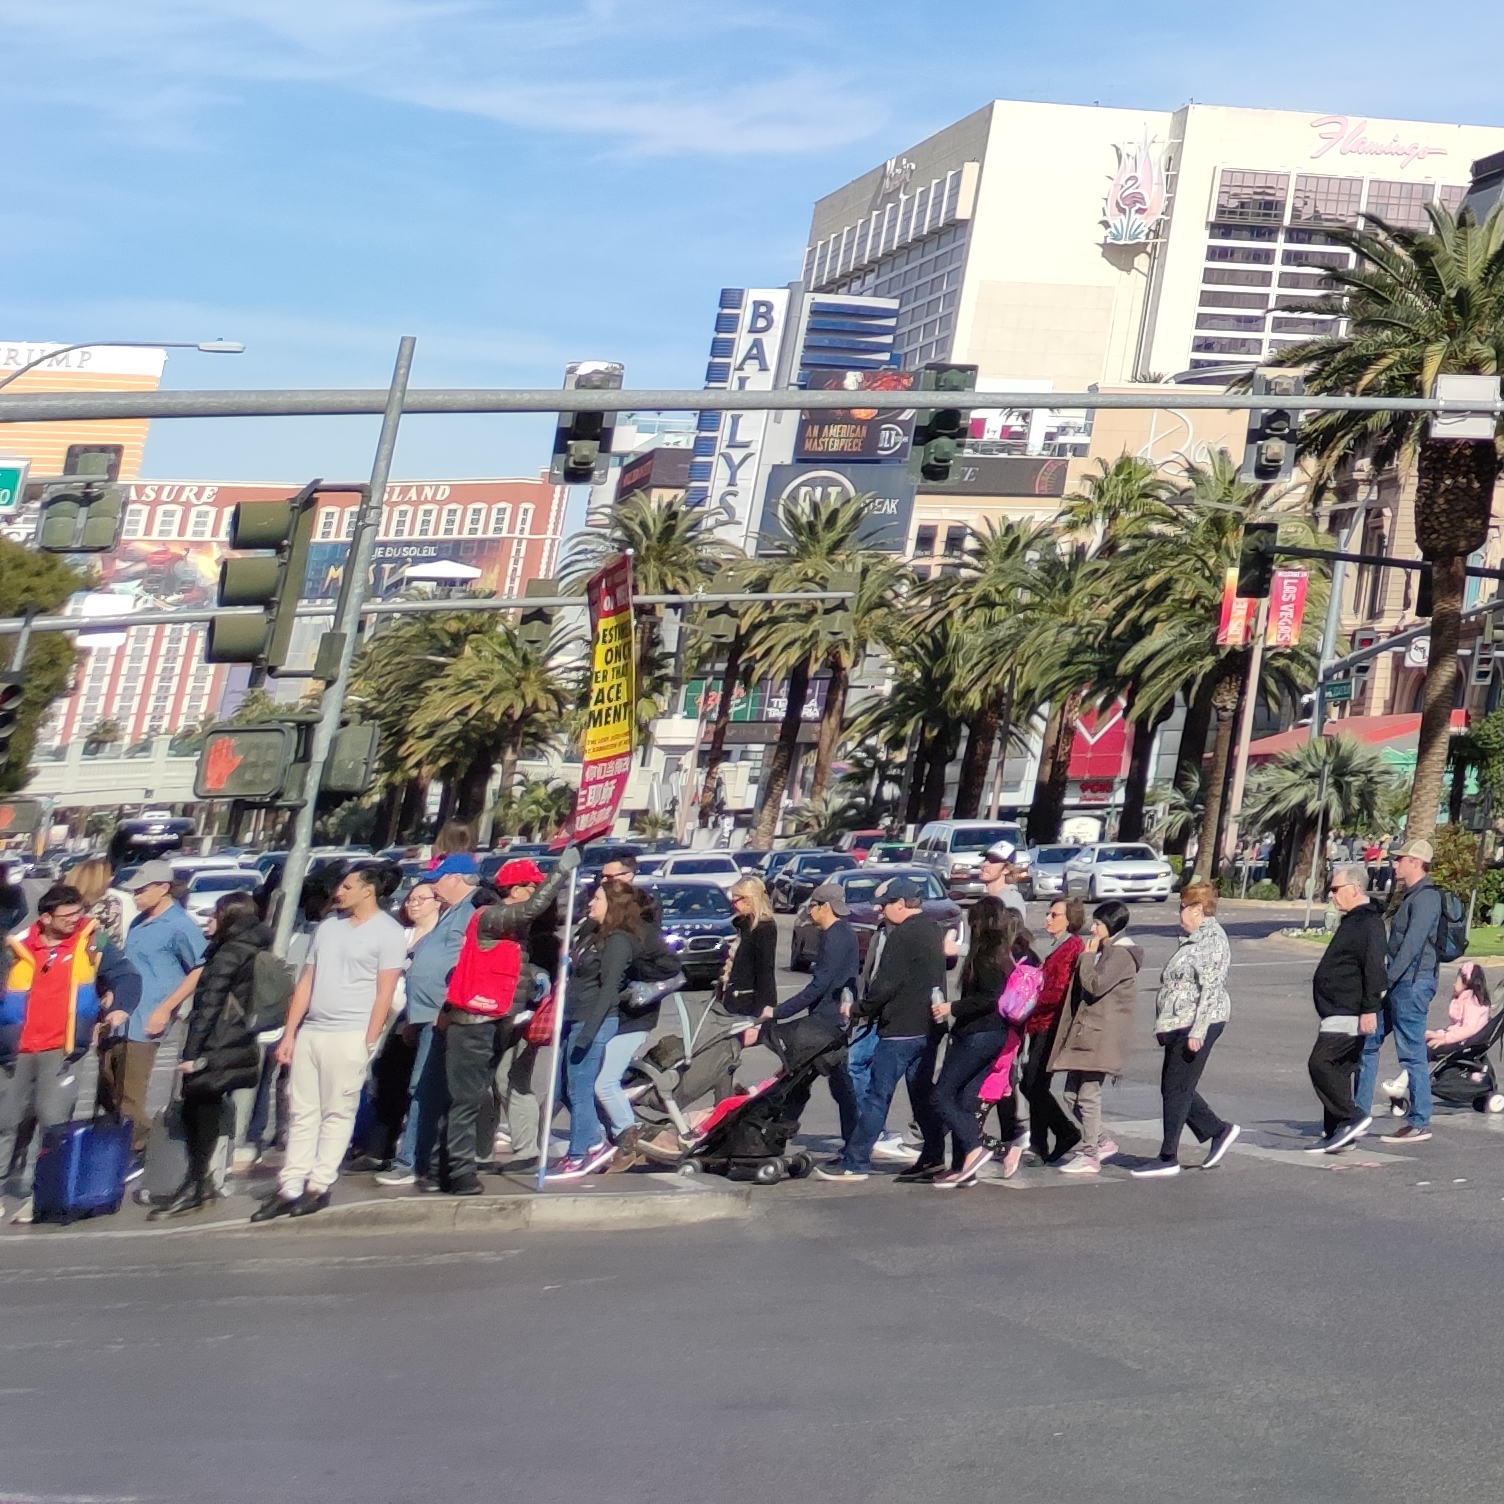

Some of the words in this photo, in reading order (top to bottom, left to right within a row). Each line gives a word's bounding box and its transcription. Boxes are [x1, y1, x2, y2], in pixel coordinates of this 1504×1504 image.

[1310, 114, 1448, 169] Flamingo
[804, 424, 819, 438] AN
[822, 422, 868, 438] AMERICAN
[804, 436, 863, 452] MASTERPIECE
